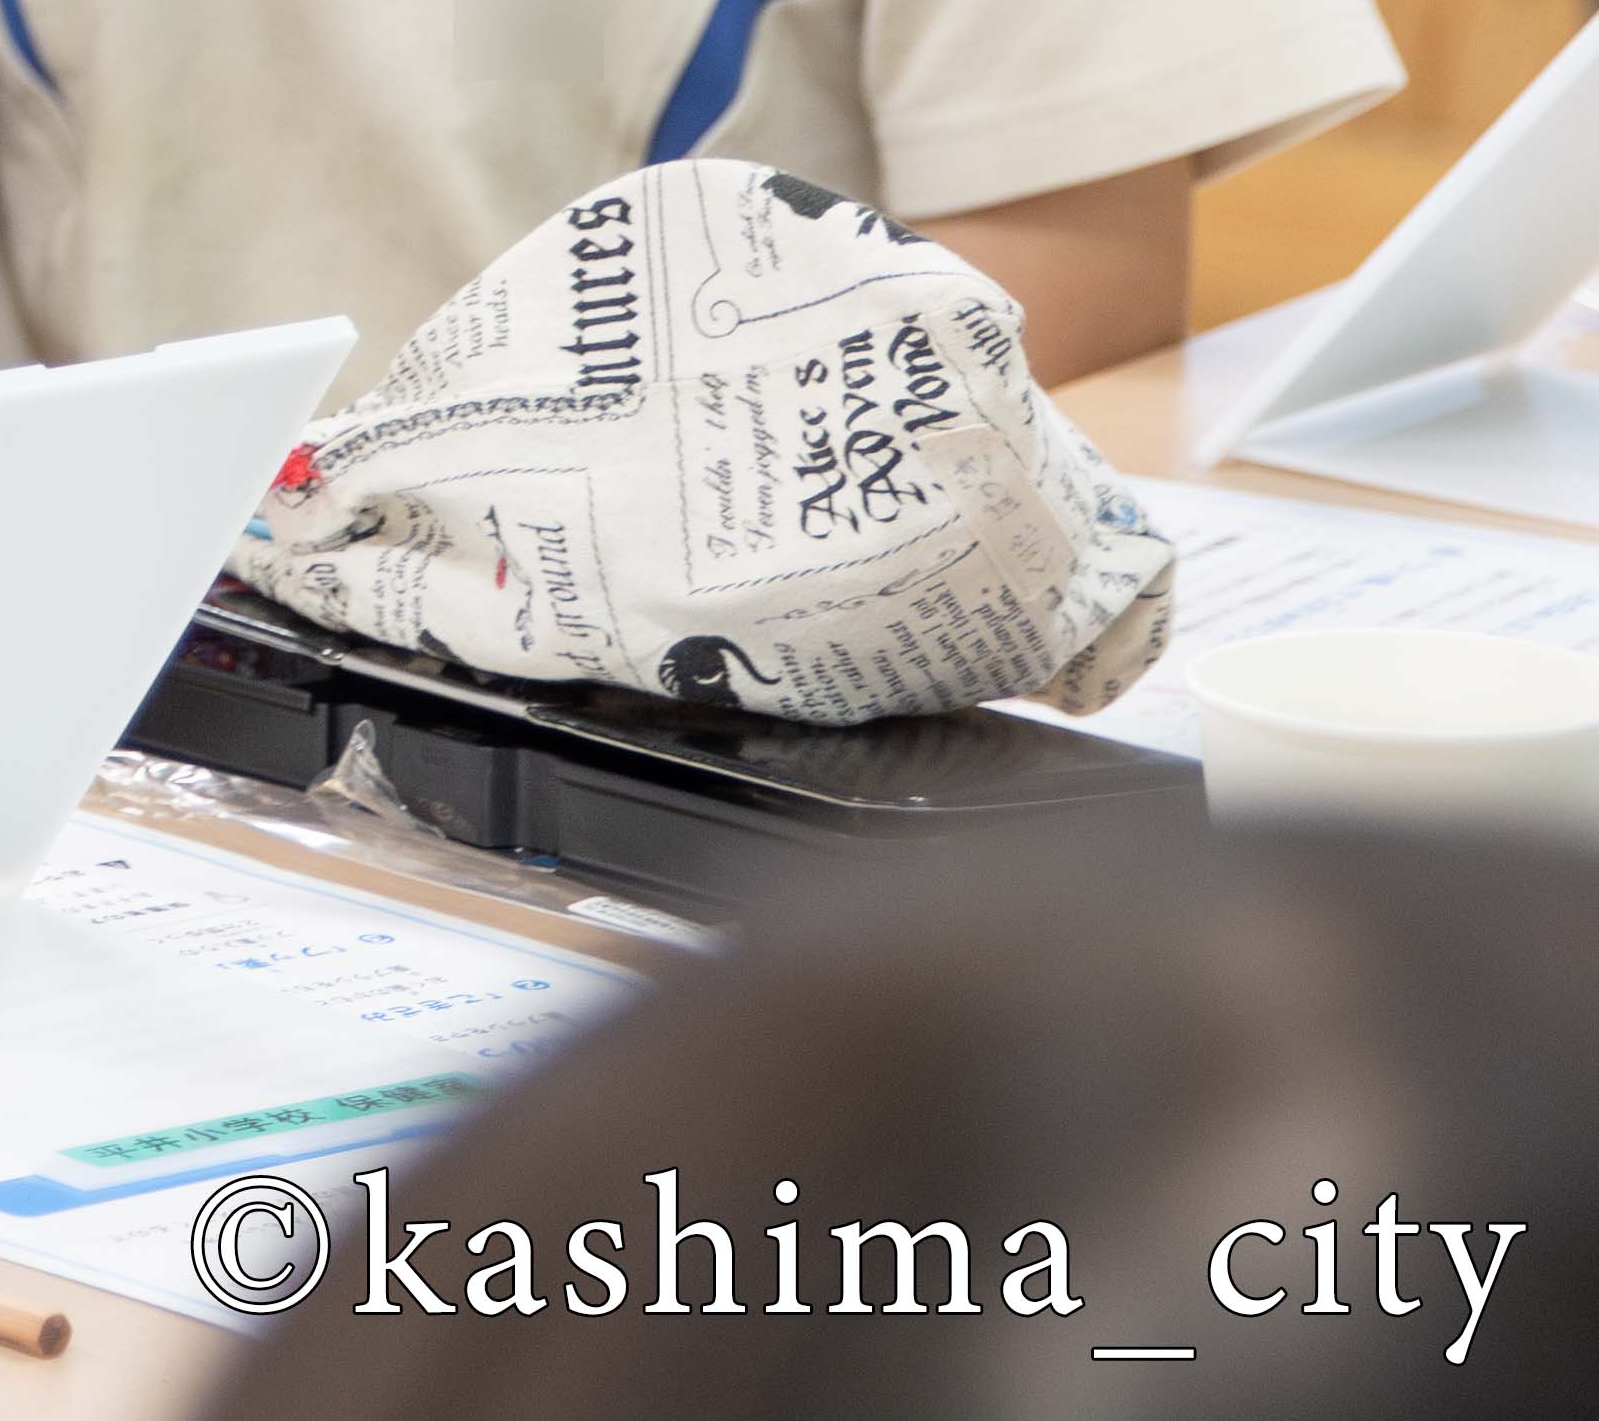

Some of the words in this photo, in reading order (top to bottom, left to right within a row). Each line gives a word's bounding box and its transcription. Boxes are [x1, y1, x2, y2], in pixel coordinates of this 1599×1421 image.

[483, 277, 512, 350] heads.
[792, 406, 860, 539] Alice
[516, 520, 613, 648] ground
[936, 588, 970, 630] think
[827, 640, 870, 691] rather
[82, 1103, 328, 1162] 平井小学校
